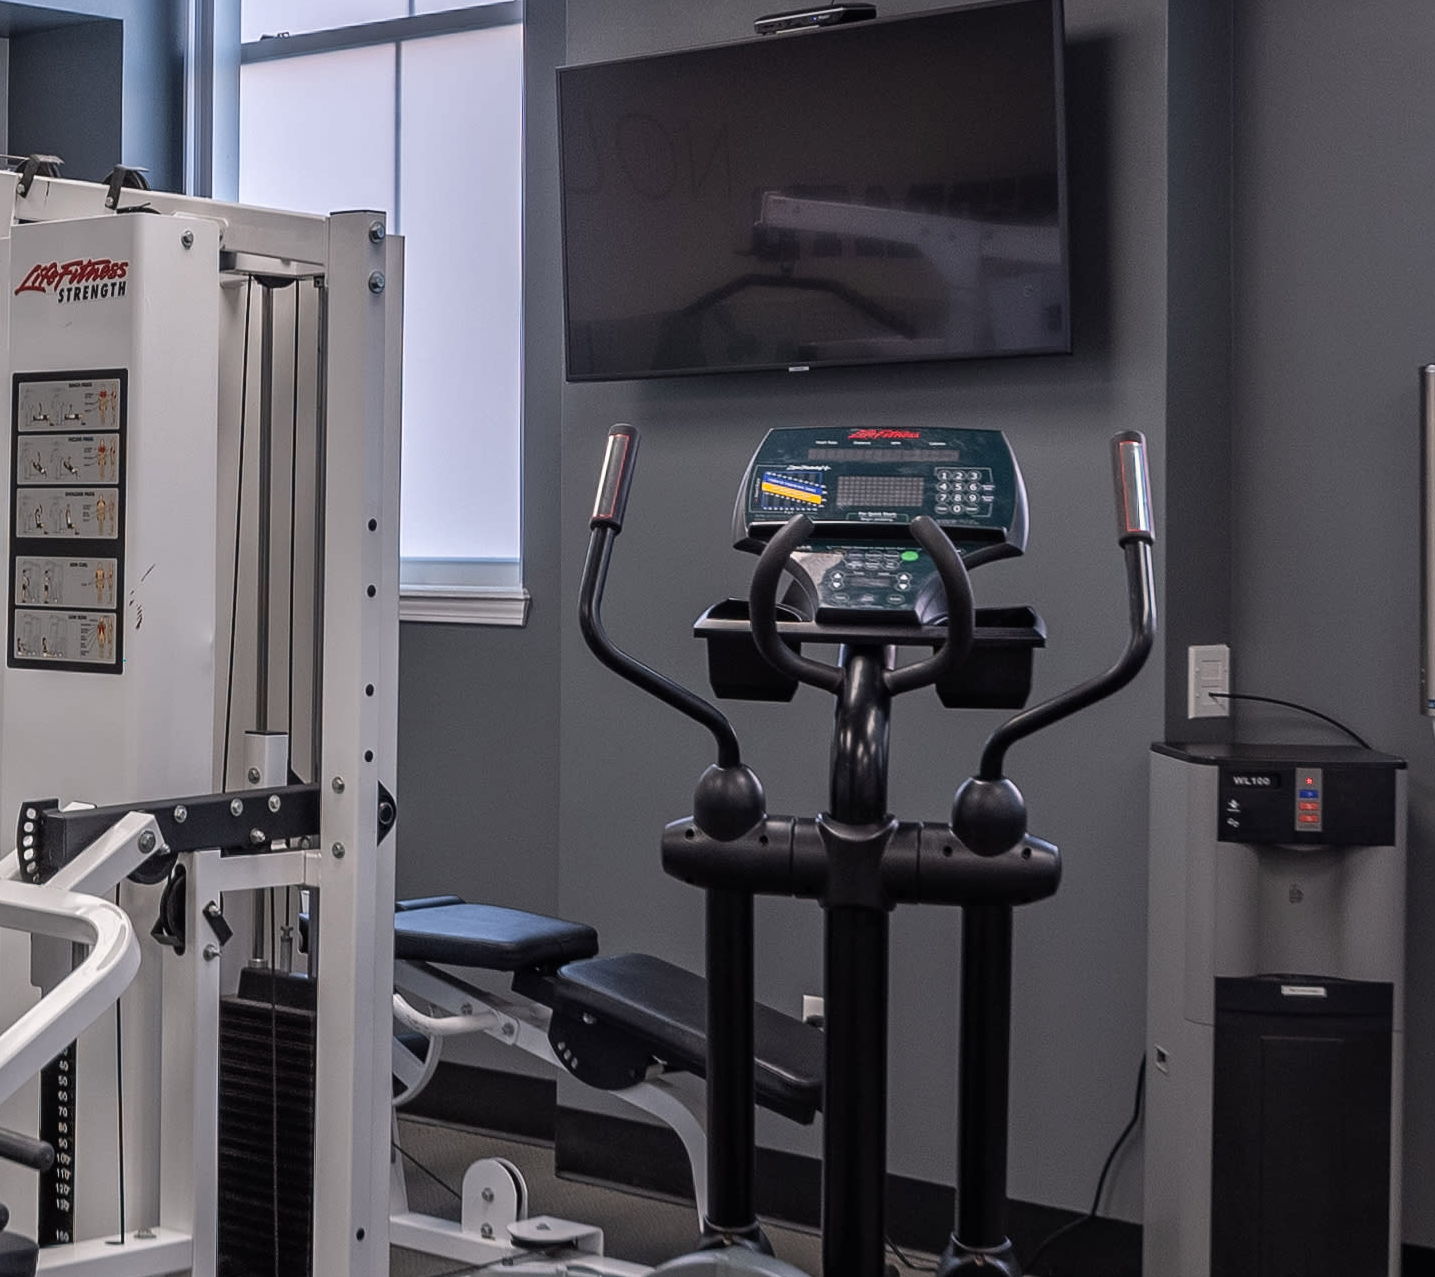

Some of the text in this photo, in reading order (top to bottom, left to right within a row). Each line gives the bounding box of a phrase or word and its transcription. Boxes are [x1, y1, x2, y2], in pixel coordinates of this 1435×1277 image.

[57, 281, 127, 303] STRENGTH
[956, 472, 963, 480] 2
[971, 472, 978, 480] 3
[939, 483, 978, 491] 4 5 6
[940, 493, 977, 502] 7 8 9
[953, 505, 961, 513] 0
[1233, 776, 1271, 786] WL100
[58, 1106, 68, 1117] 70
